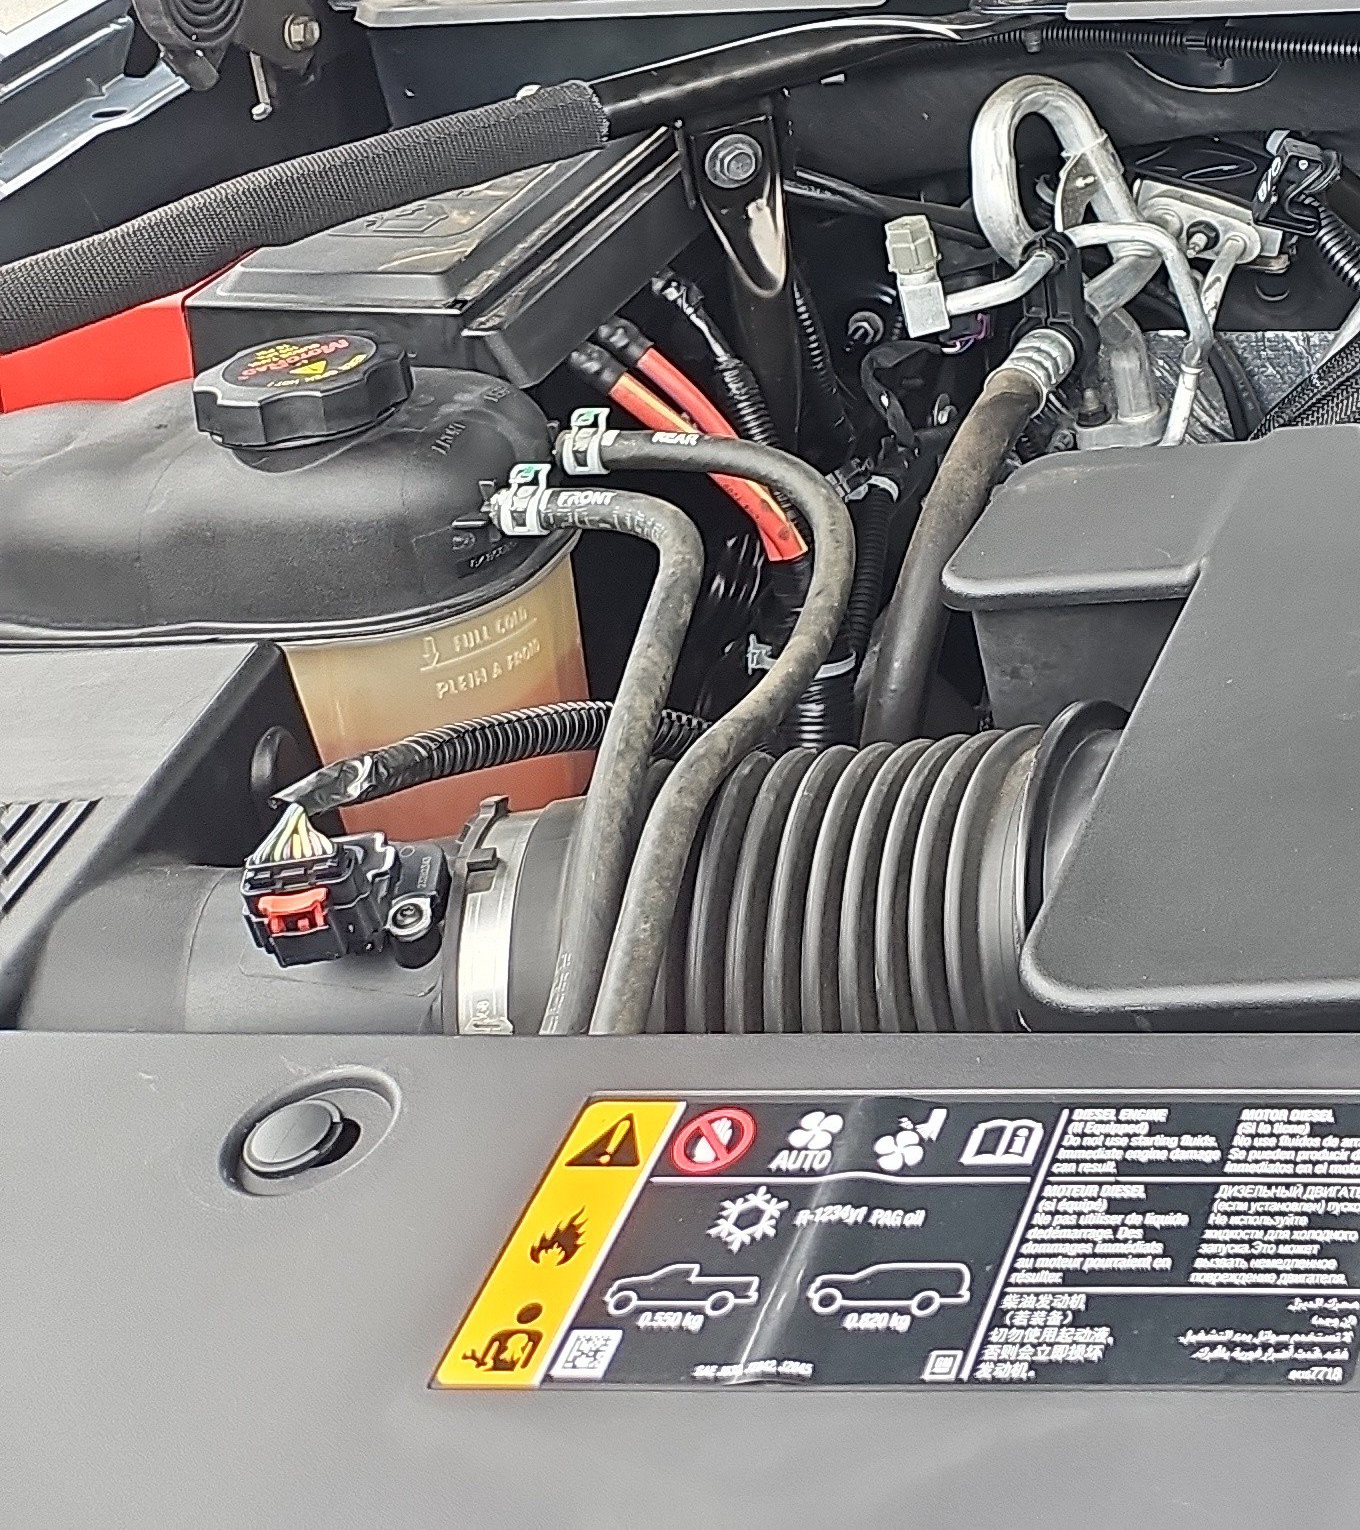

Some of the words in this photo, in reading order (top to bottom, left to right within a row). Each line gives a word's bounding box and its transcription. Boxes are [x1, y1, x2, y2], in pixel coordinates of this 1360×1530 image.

[652, 432, 700, 446] REAR
[557, 491, 618, 507] FRONT
[453, 625, 490, 652] FULL
[435, 667, 488, 699] PLEIN
[1071, 1108, 1117, 1121] DIESEL
[1118, 1108, 1169, 1122] ENGINE
[1240, 1108, 1288, 1122] MOTOR
[1289, 1108, 1335, 1123] DIESEL
[1061, 1135, 1081, 1147] Do
[1081, 1135, 1104, 1148] not
[1104, 1137, 1129, 1148] use
[1129, 1135, 1179, 1150] starting
[1232, 1135, 1252, 1147] No
[1252, 1136, 1277, 1147] use
[1277, 1135, 1322, 1149] fluidos
[1322, 1136, 1340, 1148] de
[768, 1150, 832, 1171] AUTO
[1125, 1148, 1169, 1163] engine
[1169, 1148, 1222, 1164] damage
[1227, 1148, 1247, 1160] Se
[1247, 1149, 1296, 1162] pueden
[1296, 1149, 1351, 1163] producir
[1051, 1162, 1077, 1174] can
[1295, 1163, 1313, 1175] en
[1041, 1184, 1100, 1199] MOTEUR
[1099, 1184, 1147, 1200] DIESEL
[1214, 1184, 1304, 1200] ДИЗЕЛЬНЫЙ
[868, 1209, 904, 1226] PAG
[904, 1209, 926, 1227] oil
[1031, 1212, 1052, 1226] Ne
[1052, 1215, 1078, 1228] pas
[1078, 1212, 1125, 1227] utiliser
[1124, 1213, 1144, 1227] de
[1115, 1227, 1144, 1240] Des
[1013, 1257, 1034, 1270] au
[1034, 1256, 1084, 1270] moteur
[1152, 1257, 1173, 1270] en
[999, 1293, 1086, 1311] 柴油发动机
[637, 1311, 684, 1331] 0.550
[682, 1312, 705, 1333] kg
[843, 1313, 887, 1331] 0.820
[886, 1314, 911, 1333] kg
